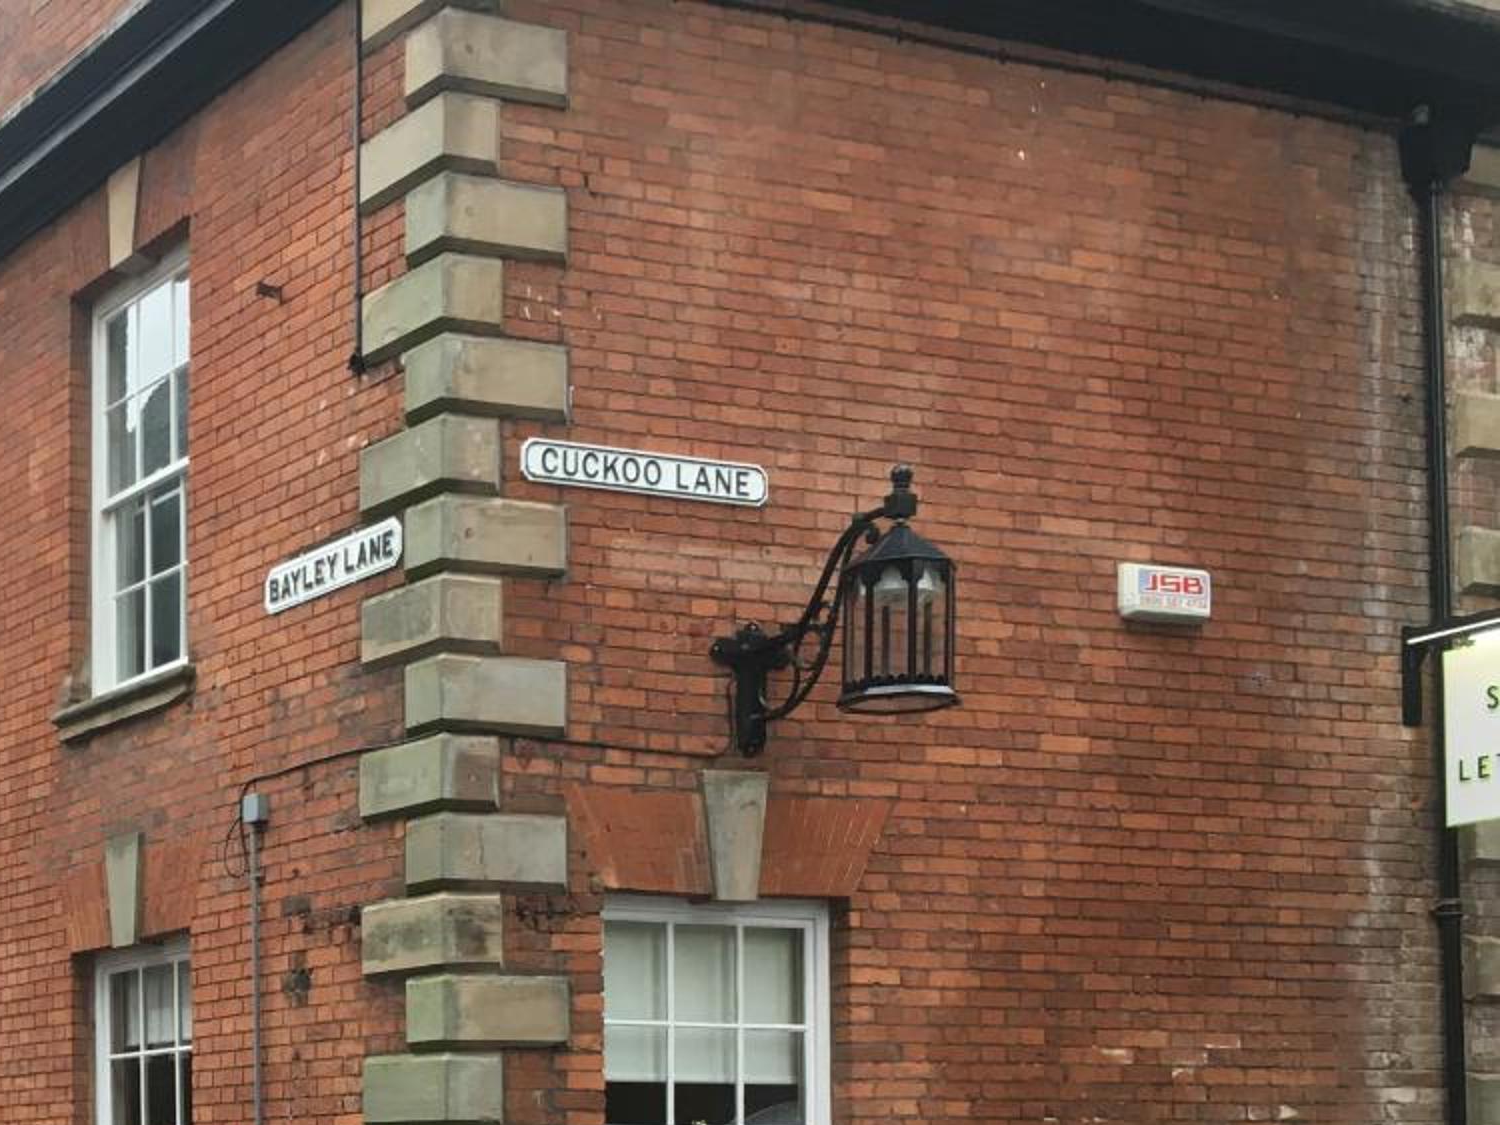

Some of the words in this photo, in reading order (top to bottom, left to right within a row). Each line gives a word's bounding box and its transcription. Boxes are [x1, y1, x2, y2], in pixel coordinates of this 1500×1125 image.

[541, 447, 662, 486] CUCKOO
[675, 463, 750, 497] LANE
[269, 552, 338, 604] BAYLEY
[343, 529, 394, 574] LANE
[1459, 752, 1500, 781] LE
